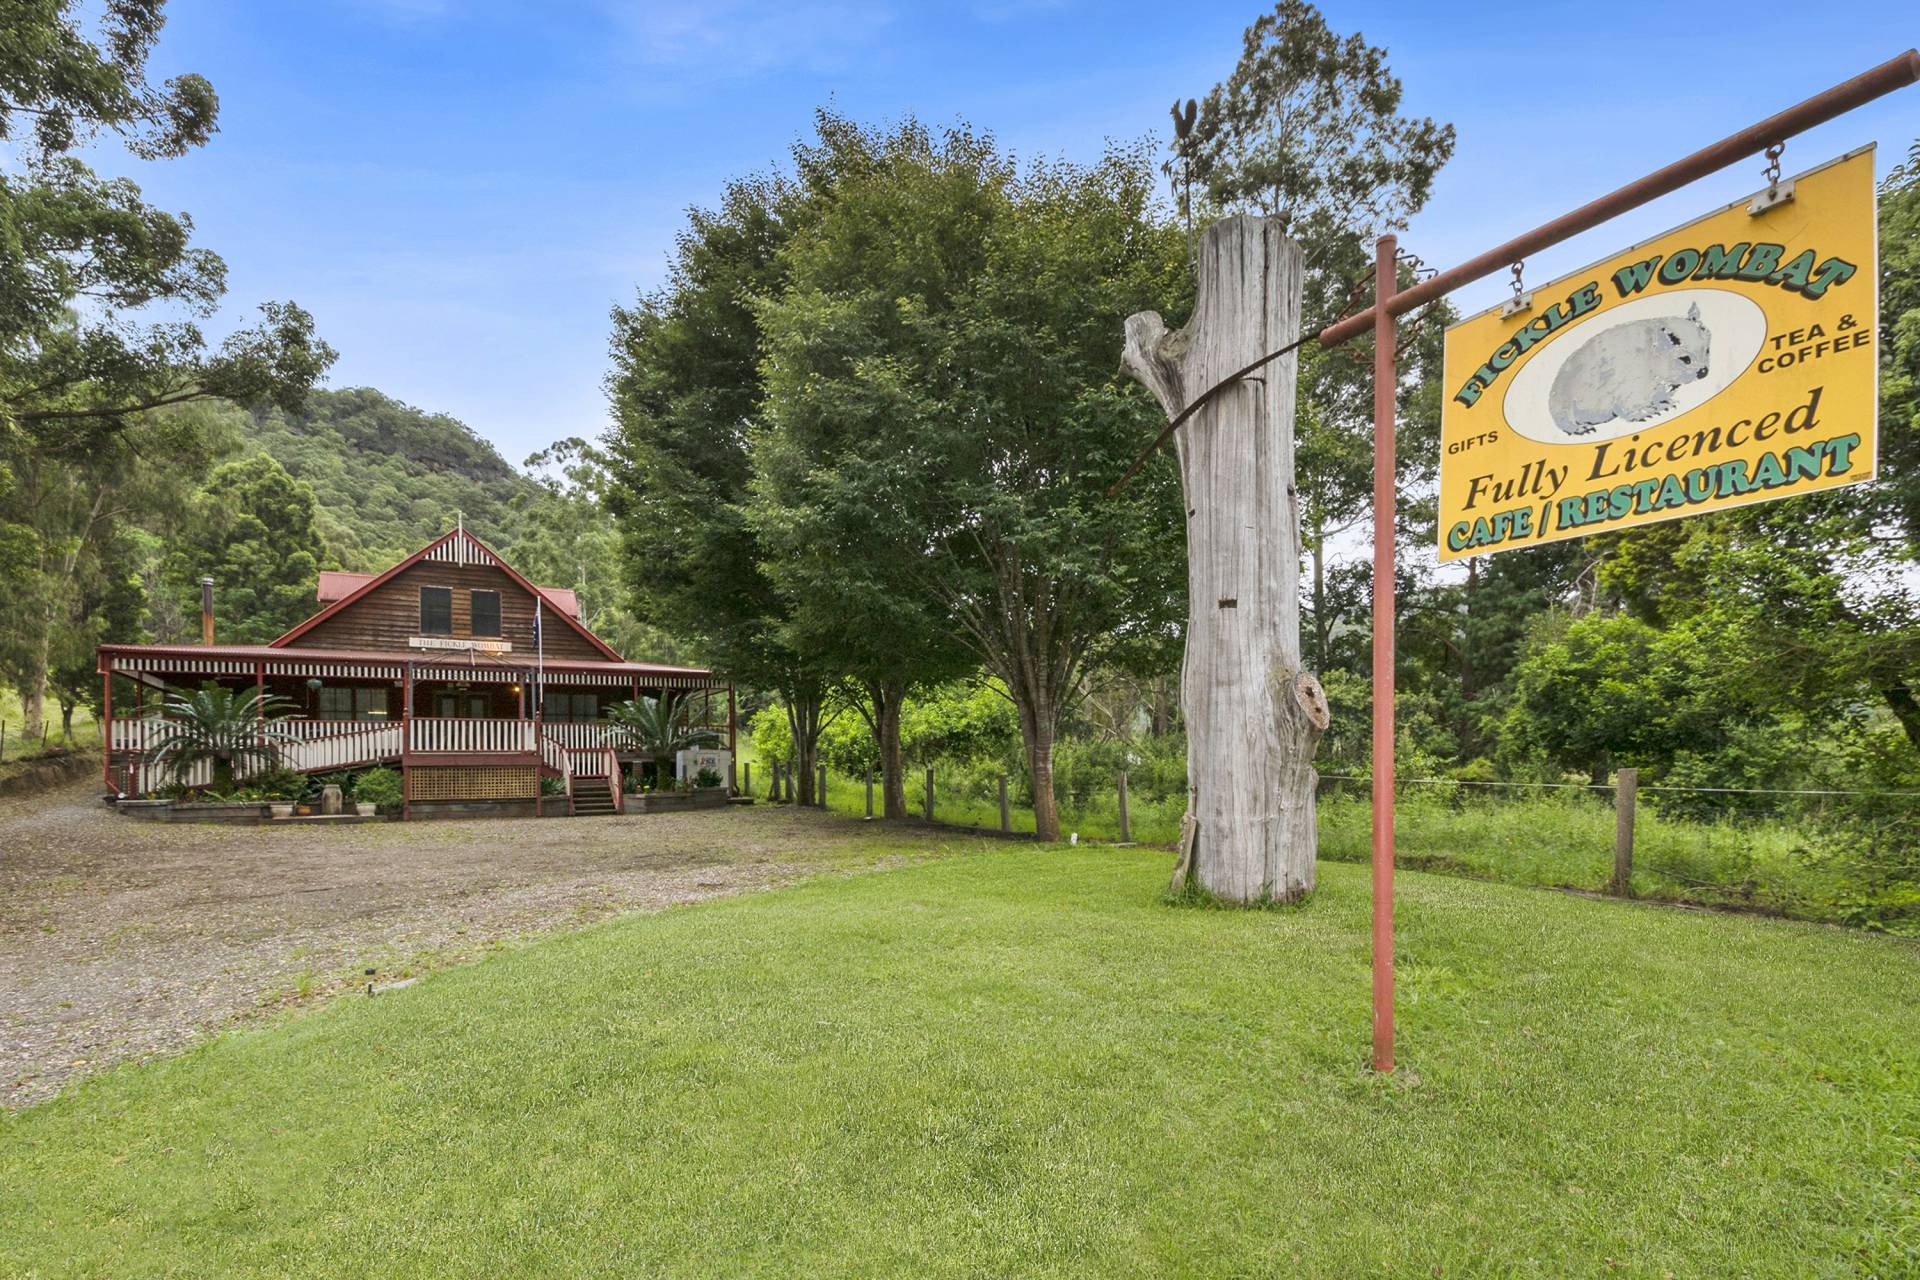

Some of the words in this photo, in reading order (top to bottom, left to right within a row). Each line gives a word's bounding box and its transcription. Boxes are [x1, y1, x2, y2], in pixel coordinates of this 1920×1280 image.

[1453, 281, 1603, 409] FICKLE
[1611, 242, 1857, 301] WOMBAT
[1770, 323, 1825, 351] TEA
[1837, 313, 1858, 330] &
[1757, 328, 1870, 374] COFFEE
[1448, 430, 1498, 455] GIFTS
[1462, 458, 1569, 511] Fully
[1586, 386, 1824, 483] Licenced
